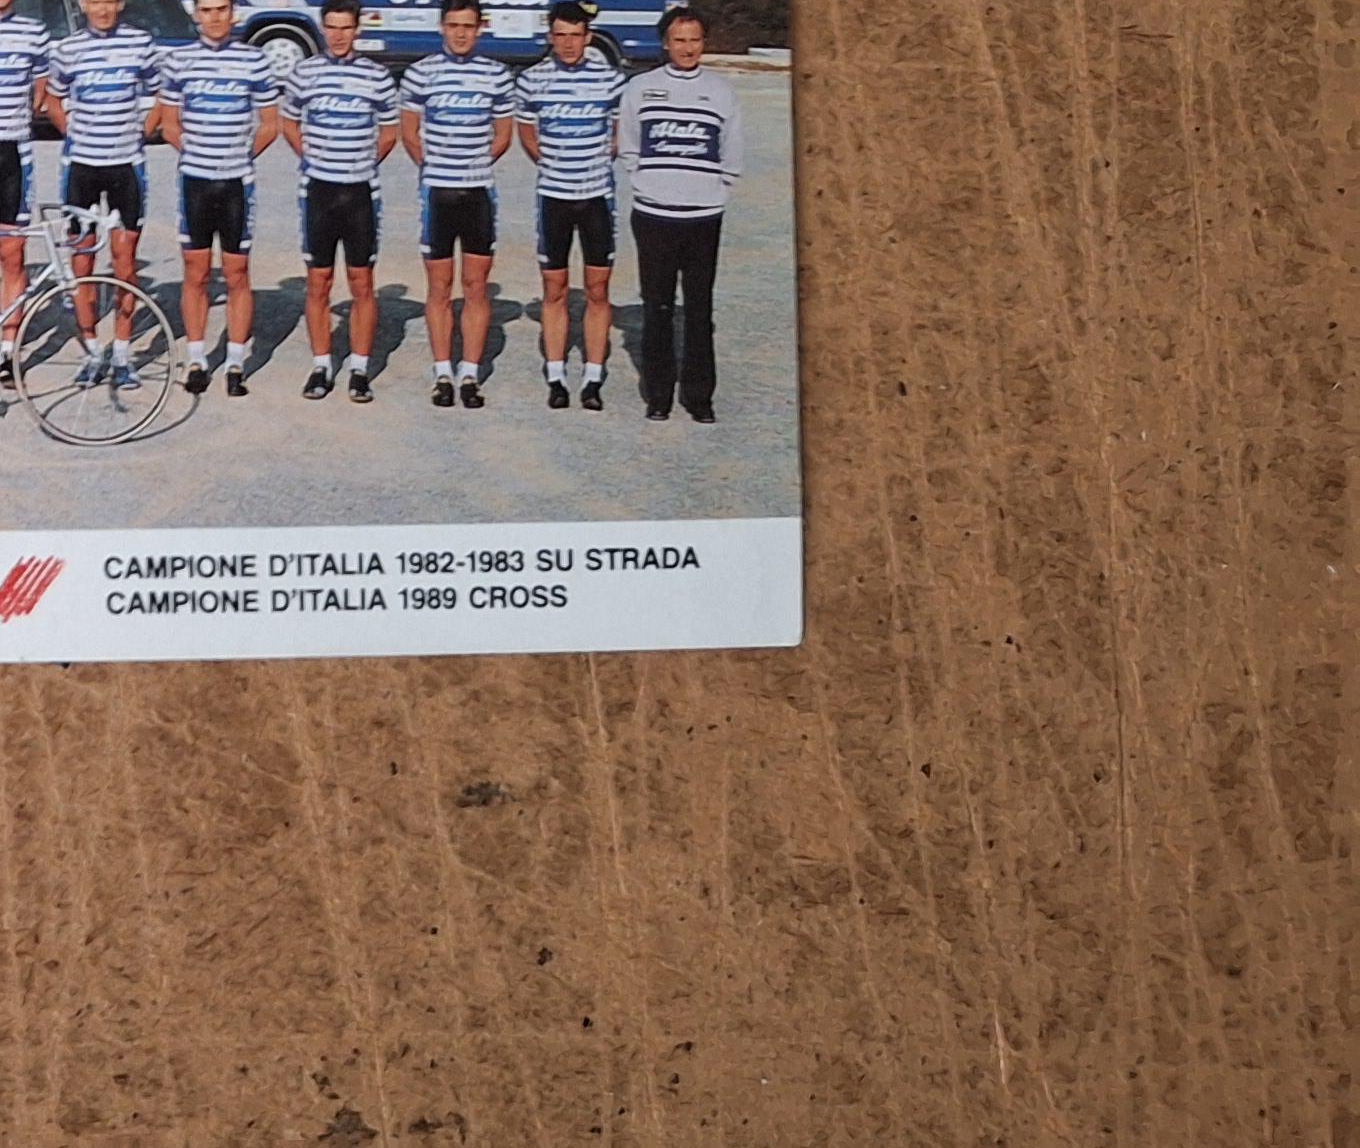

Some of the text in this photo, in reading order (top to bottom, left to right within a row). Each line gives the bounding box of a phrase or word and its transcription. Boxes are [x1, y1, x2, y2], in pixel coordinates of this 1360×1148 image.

[104, 546, 700, 580] CAMPIONE D'ITALIA 1982-1983 SU STRADA
[106, 584, 568, 615] CAMPIONE D'ITALIA 1989 CROSS
